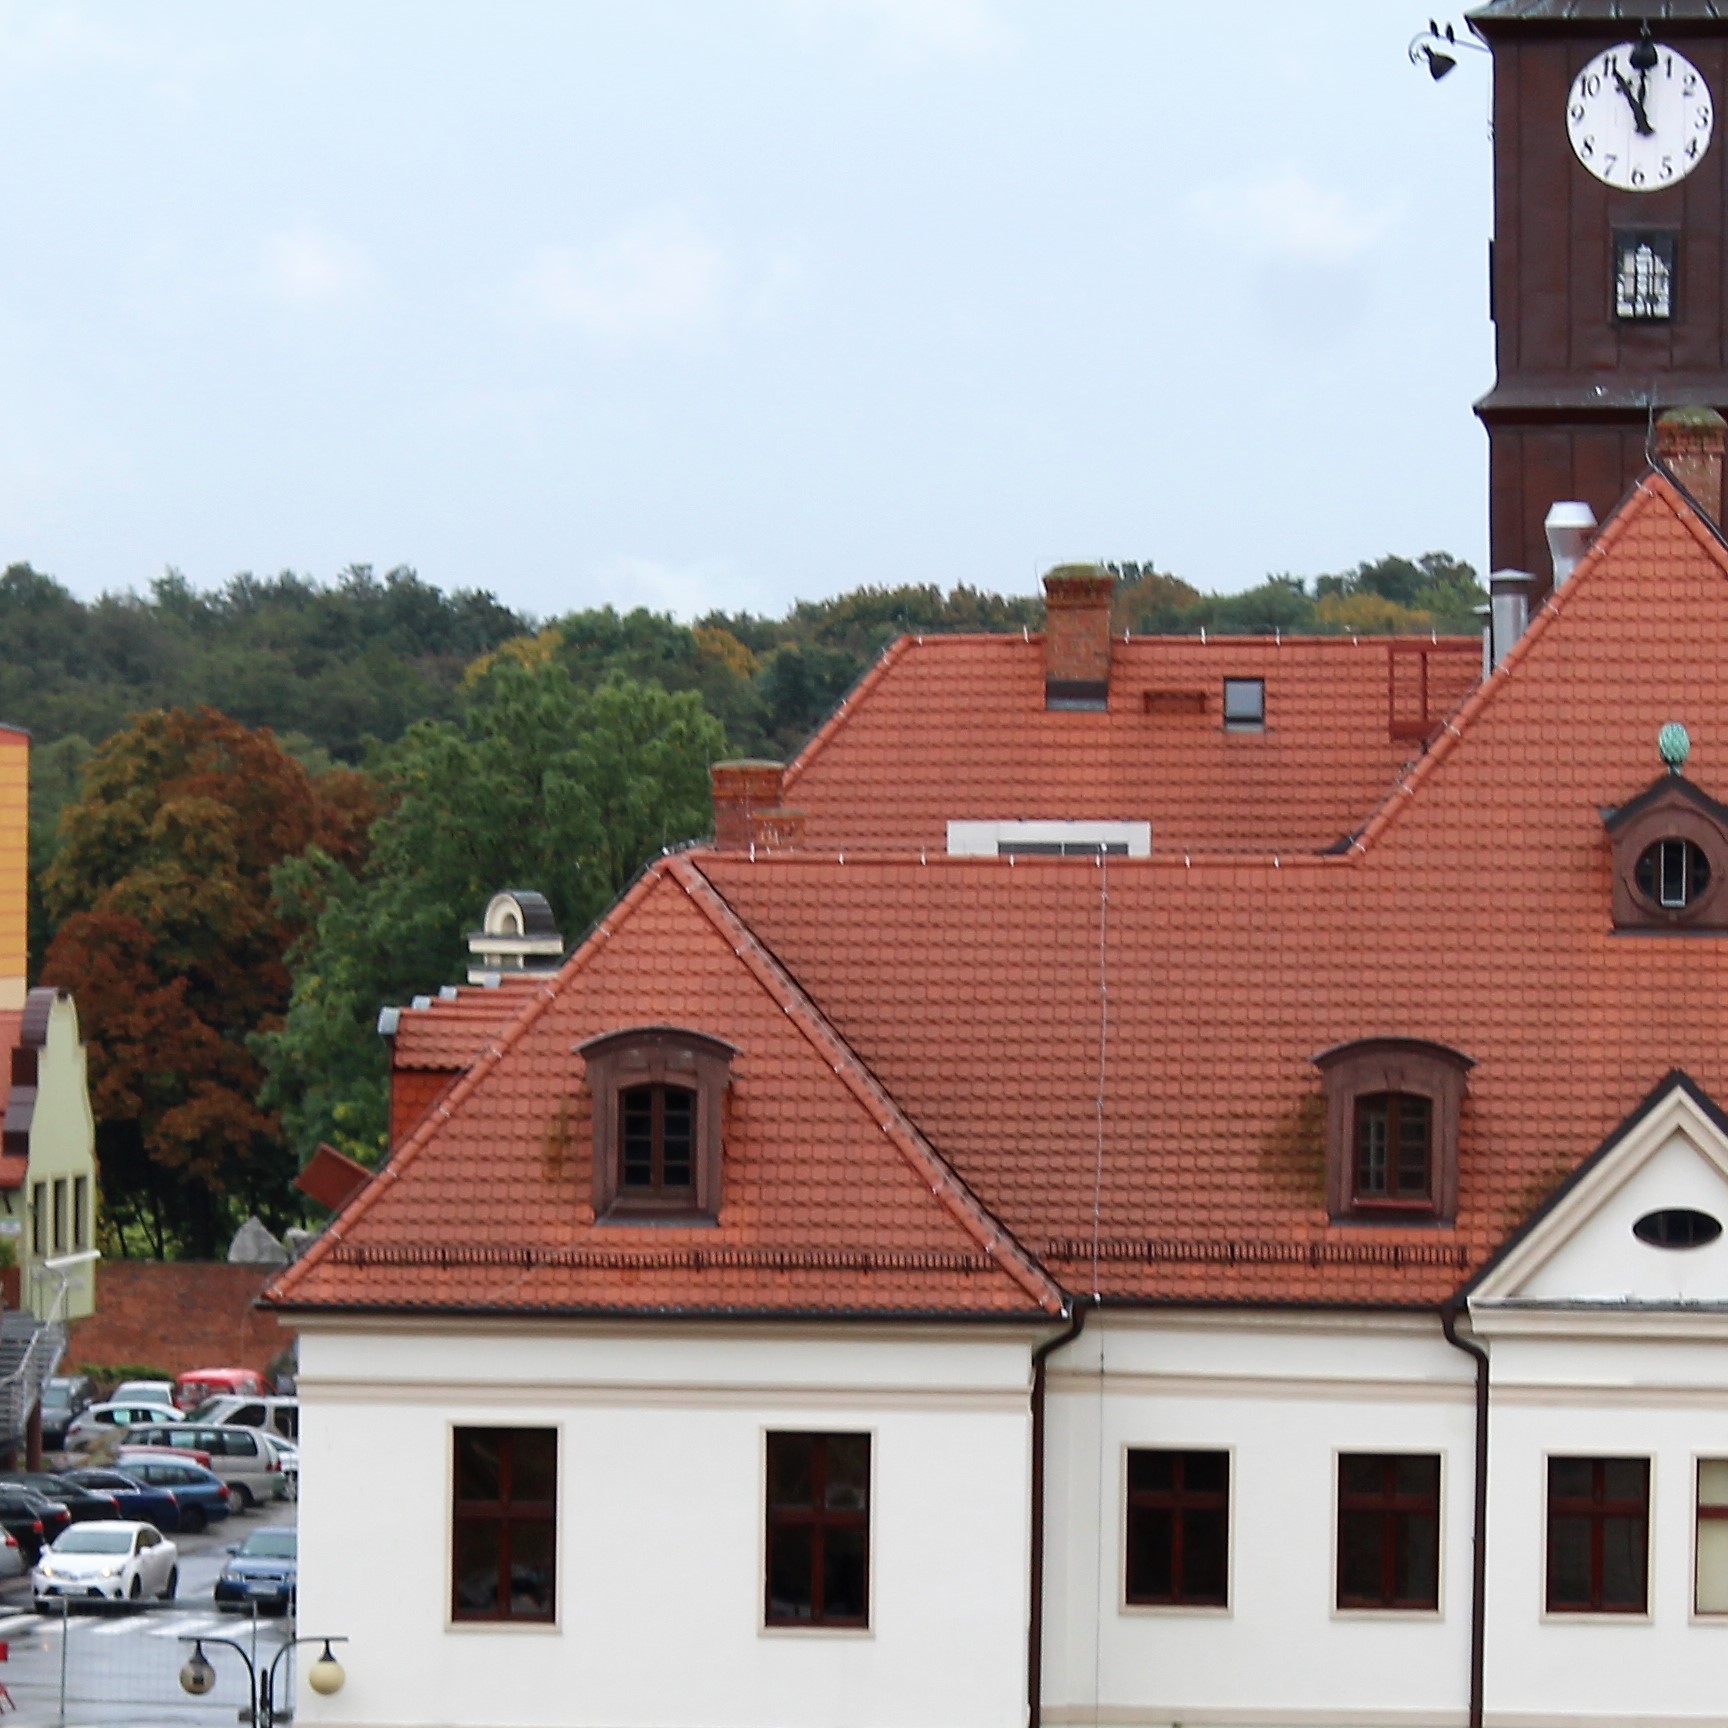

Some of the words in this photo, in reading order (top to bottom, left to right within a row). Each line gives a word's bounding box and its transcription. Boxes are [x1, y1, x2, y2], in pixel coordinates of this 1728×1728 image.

[1665, 55, 1673, 79] 1
[1580, 73, 1601, 98] 10
[1683, 74, 1697, 98] 2
[1571, 104, 1585, 123] 9
[1695, 105, 1709, 130] 3
[1581, 135, 1595, 159] 8
[1684, 136, 1700, 160] 4
[1604, 153, 1618, 178] 7
[1631, 163, 1646, 186] 6
[1659, 156, 1674, 179] 5
